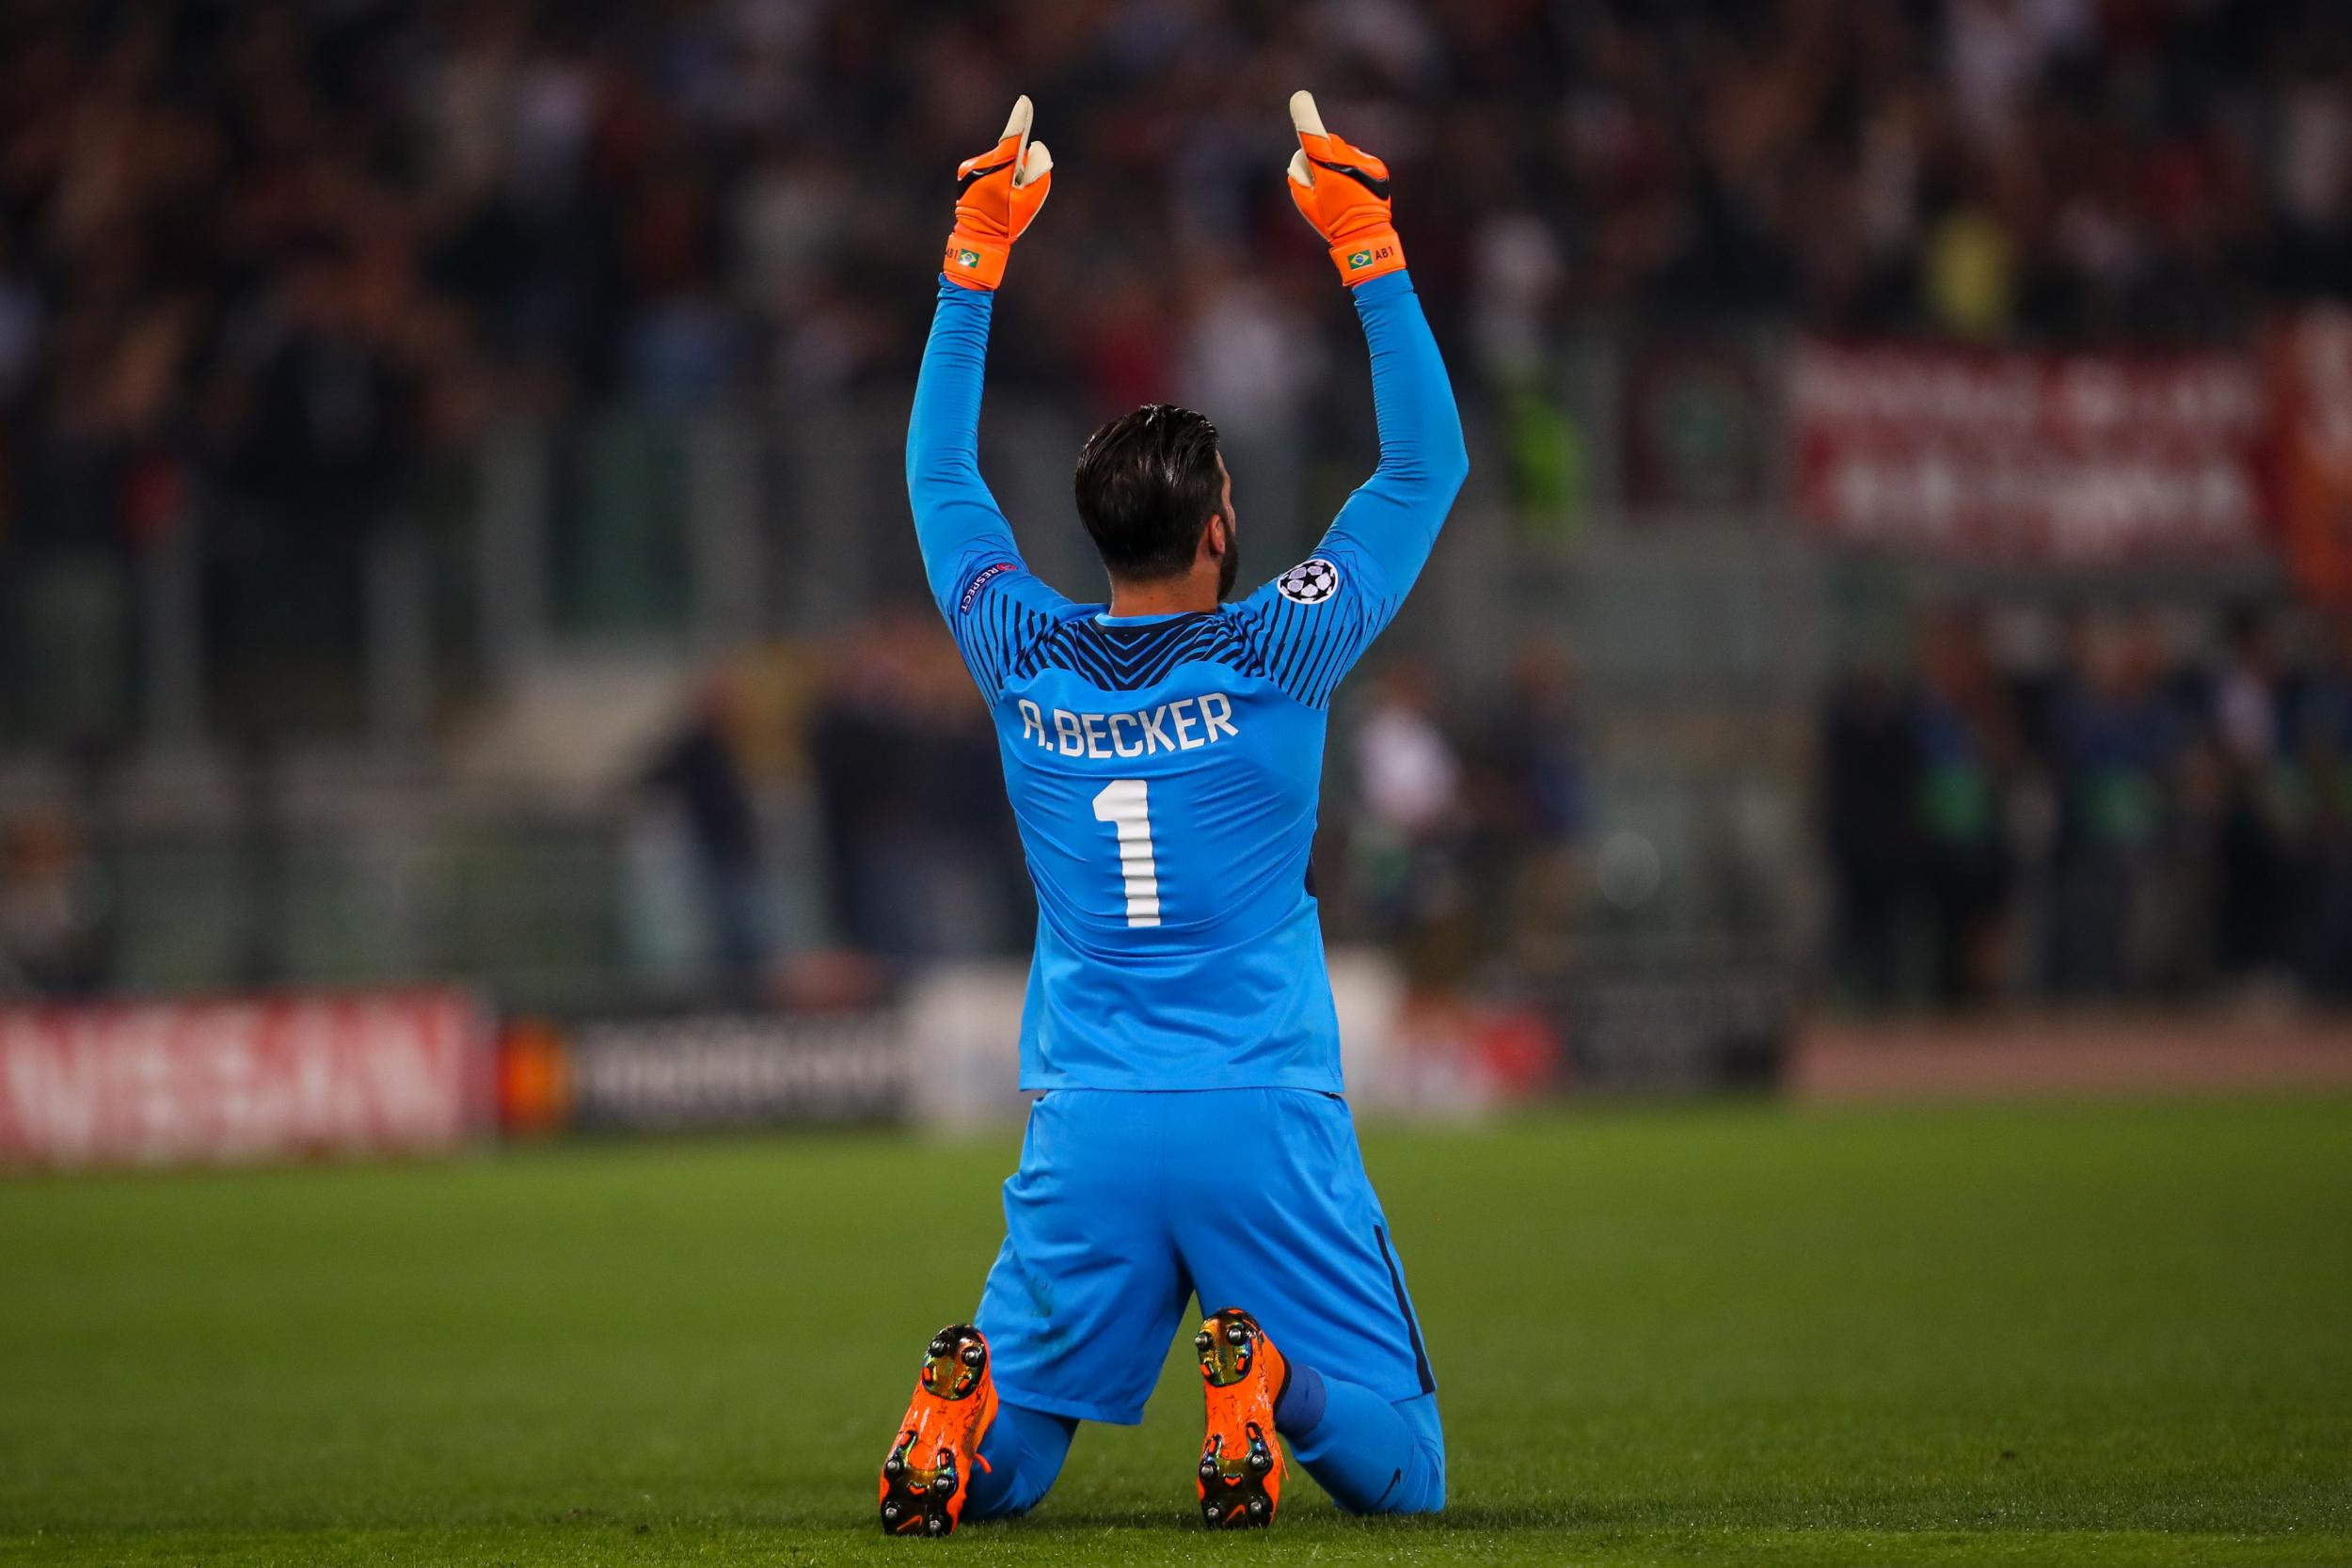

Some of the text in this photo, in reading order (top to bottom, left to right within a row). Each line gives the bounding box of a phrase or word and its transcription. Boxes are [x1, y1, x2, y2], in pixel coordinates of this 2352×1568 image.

[1375, 245, 1394, 261] AB1
[961, 567, 999, 612] RESPECT
[1018, 692, 1239, 758] A.BECKER
[1092, 779, 1161, 927] 1
